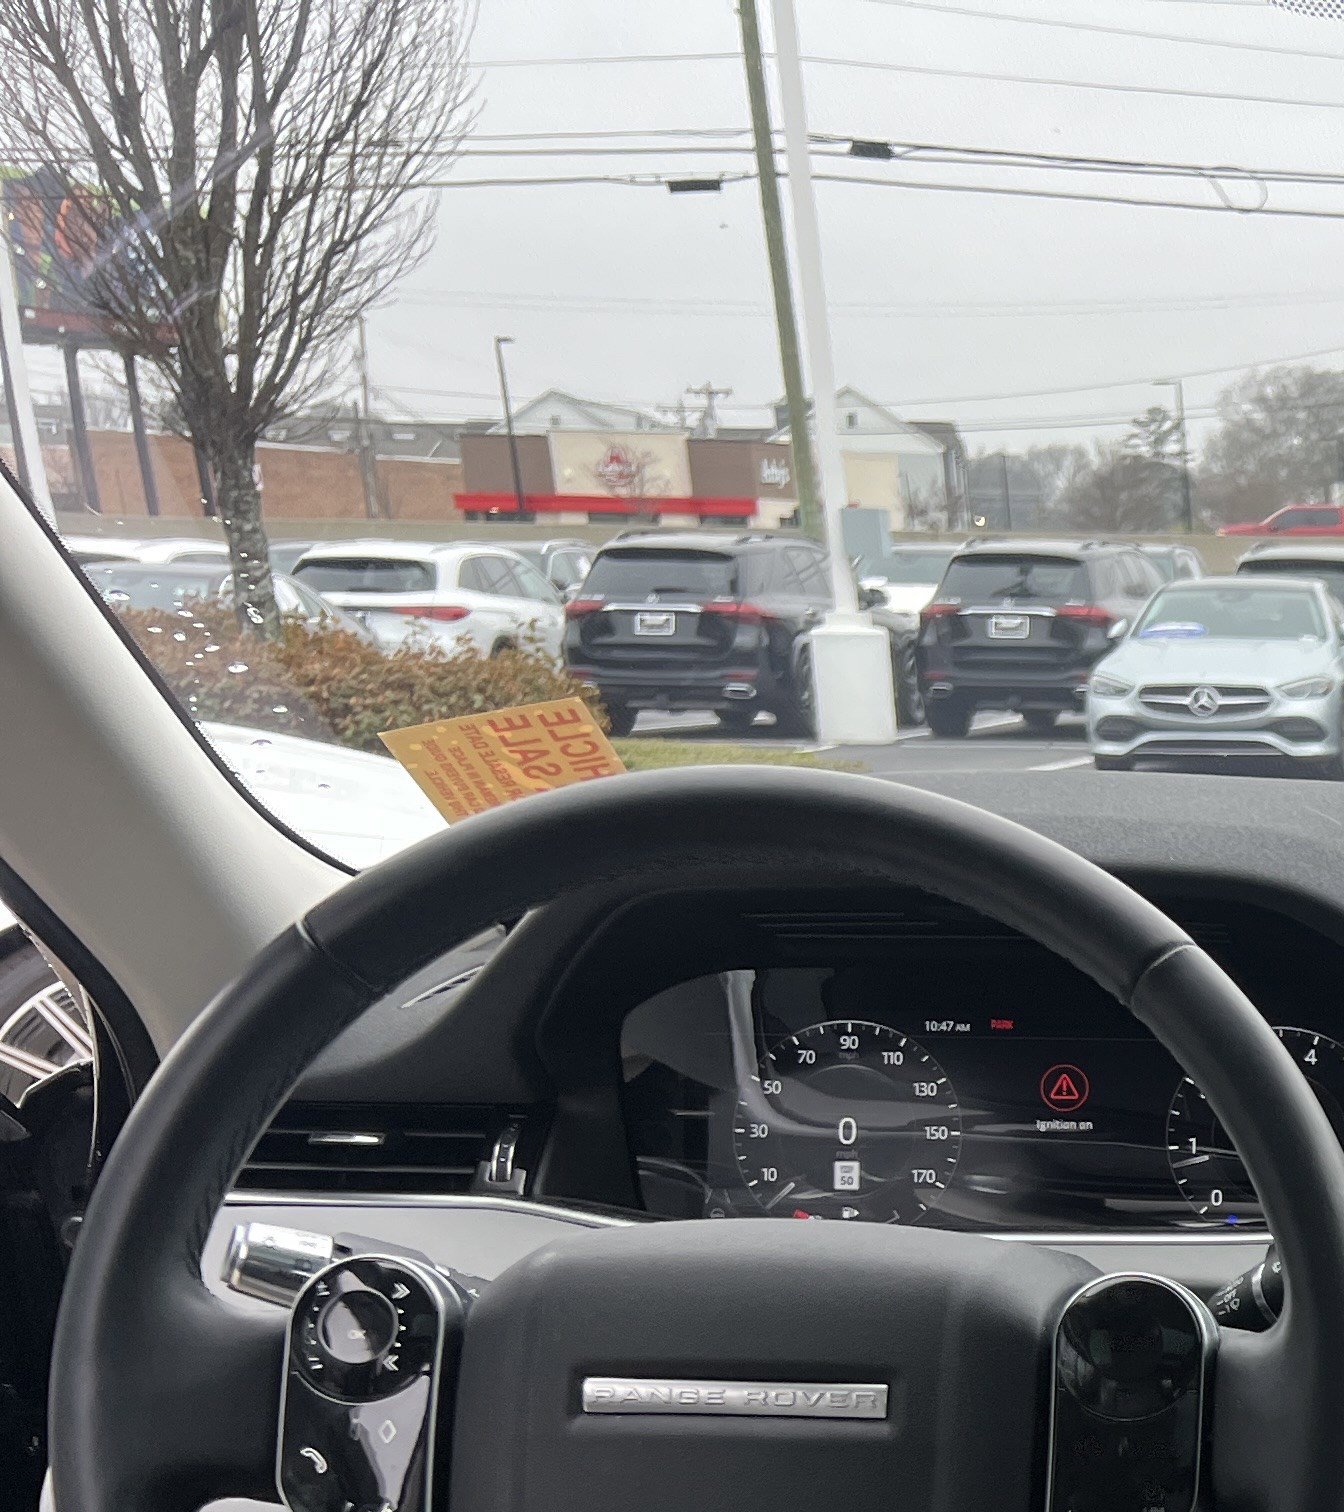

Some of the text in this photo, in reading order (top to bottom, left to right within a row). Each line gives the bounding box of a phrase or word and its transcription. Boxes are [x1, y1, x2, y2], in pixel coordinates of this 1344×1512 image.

[924, 1020, 971, 1032] 10:47 AM
[990, 1019, 1014, 1030] PARK
[839, 1035, 860, 1050] 90
[797, 1050, 816, 1064] 70
[882, 1051, 904, 1066] 110
[1304, 1049, 1318, 1066] 4
[763, 1080, 782, 1095] 50
[913, 1082, 938, 1097] 130
[750, 1124, 769, 1139] 30
[838, 1117, 858, 1145] 0
[924, 1126, 949, 1140] 150
[1036, 1119, 1094, 1132] Ignition on
[1188, 1137, 1198, 1155] 1
[761, 1167, 778, 1182] 10
[840, 1175, 854, 1186] 50
[912, 1169, 936, 1184] 170
[1211, 1189, 1223, 1207] 0
[592, 1386, 878, 1410] RANGE ROVER
